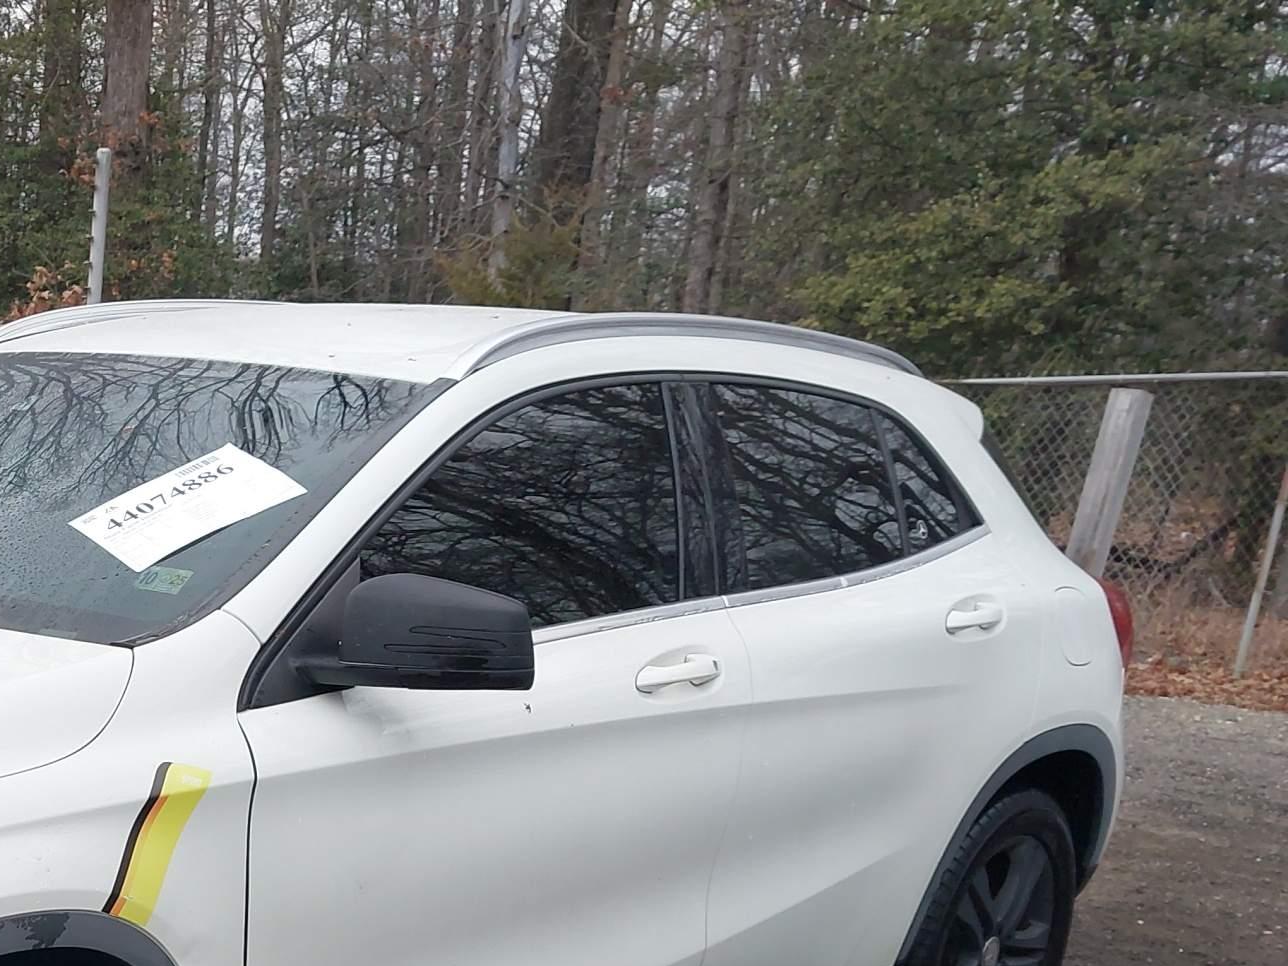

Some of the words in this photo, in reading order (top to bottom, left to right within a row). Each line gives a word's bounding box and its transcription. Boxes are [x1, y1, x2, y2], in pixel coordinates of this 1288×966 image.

[107, 463, 234, 530] 44074886
[139, 571, 158, 585] 10
[168, 574, 188, 586] 25
